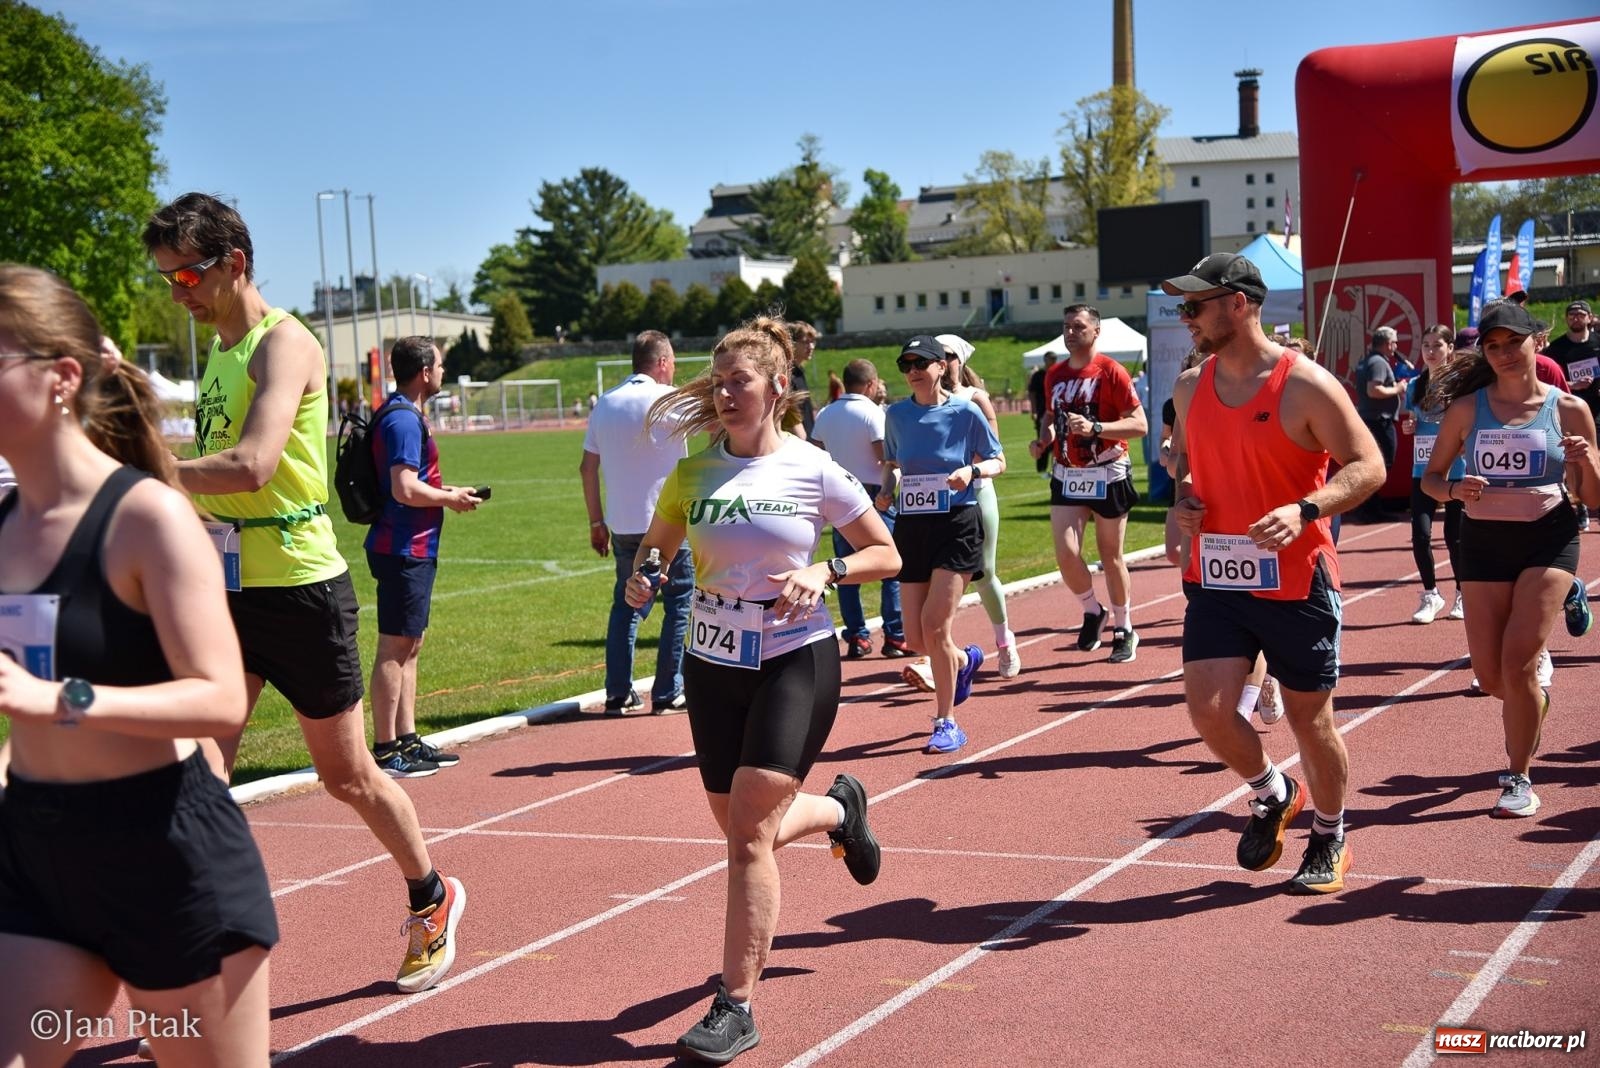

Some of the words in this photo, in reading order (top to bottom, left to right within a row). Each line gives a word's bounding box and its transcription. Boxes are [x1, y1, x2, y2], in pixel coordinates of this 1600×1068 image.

[1051, 378, 1098, 411] RUN
[1418, 447, 1431, 459] 05
[1481, 451, 1526, 470] 049
[1069, 481, 1095, 493] 047
[755, 502, 794, 513] TEAM
[905, 491, 936, 507] 064
[1209, 558, 1256, 580] 060
[696, 621, 735, 654] 074
